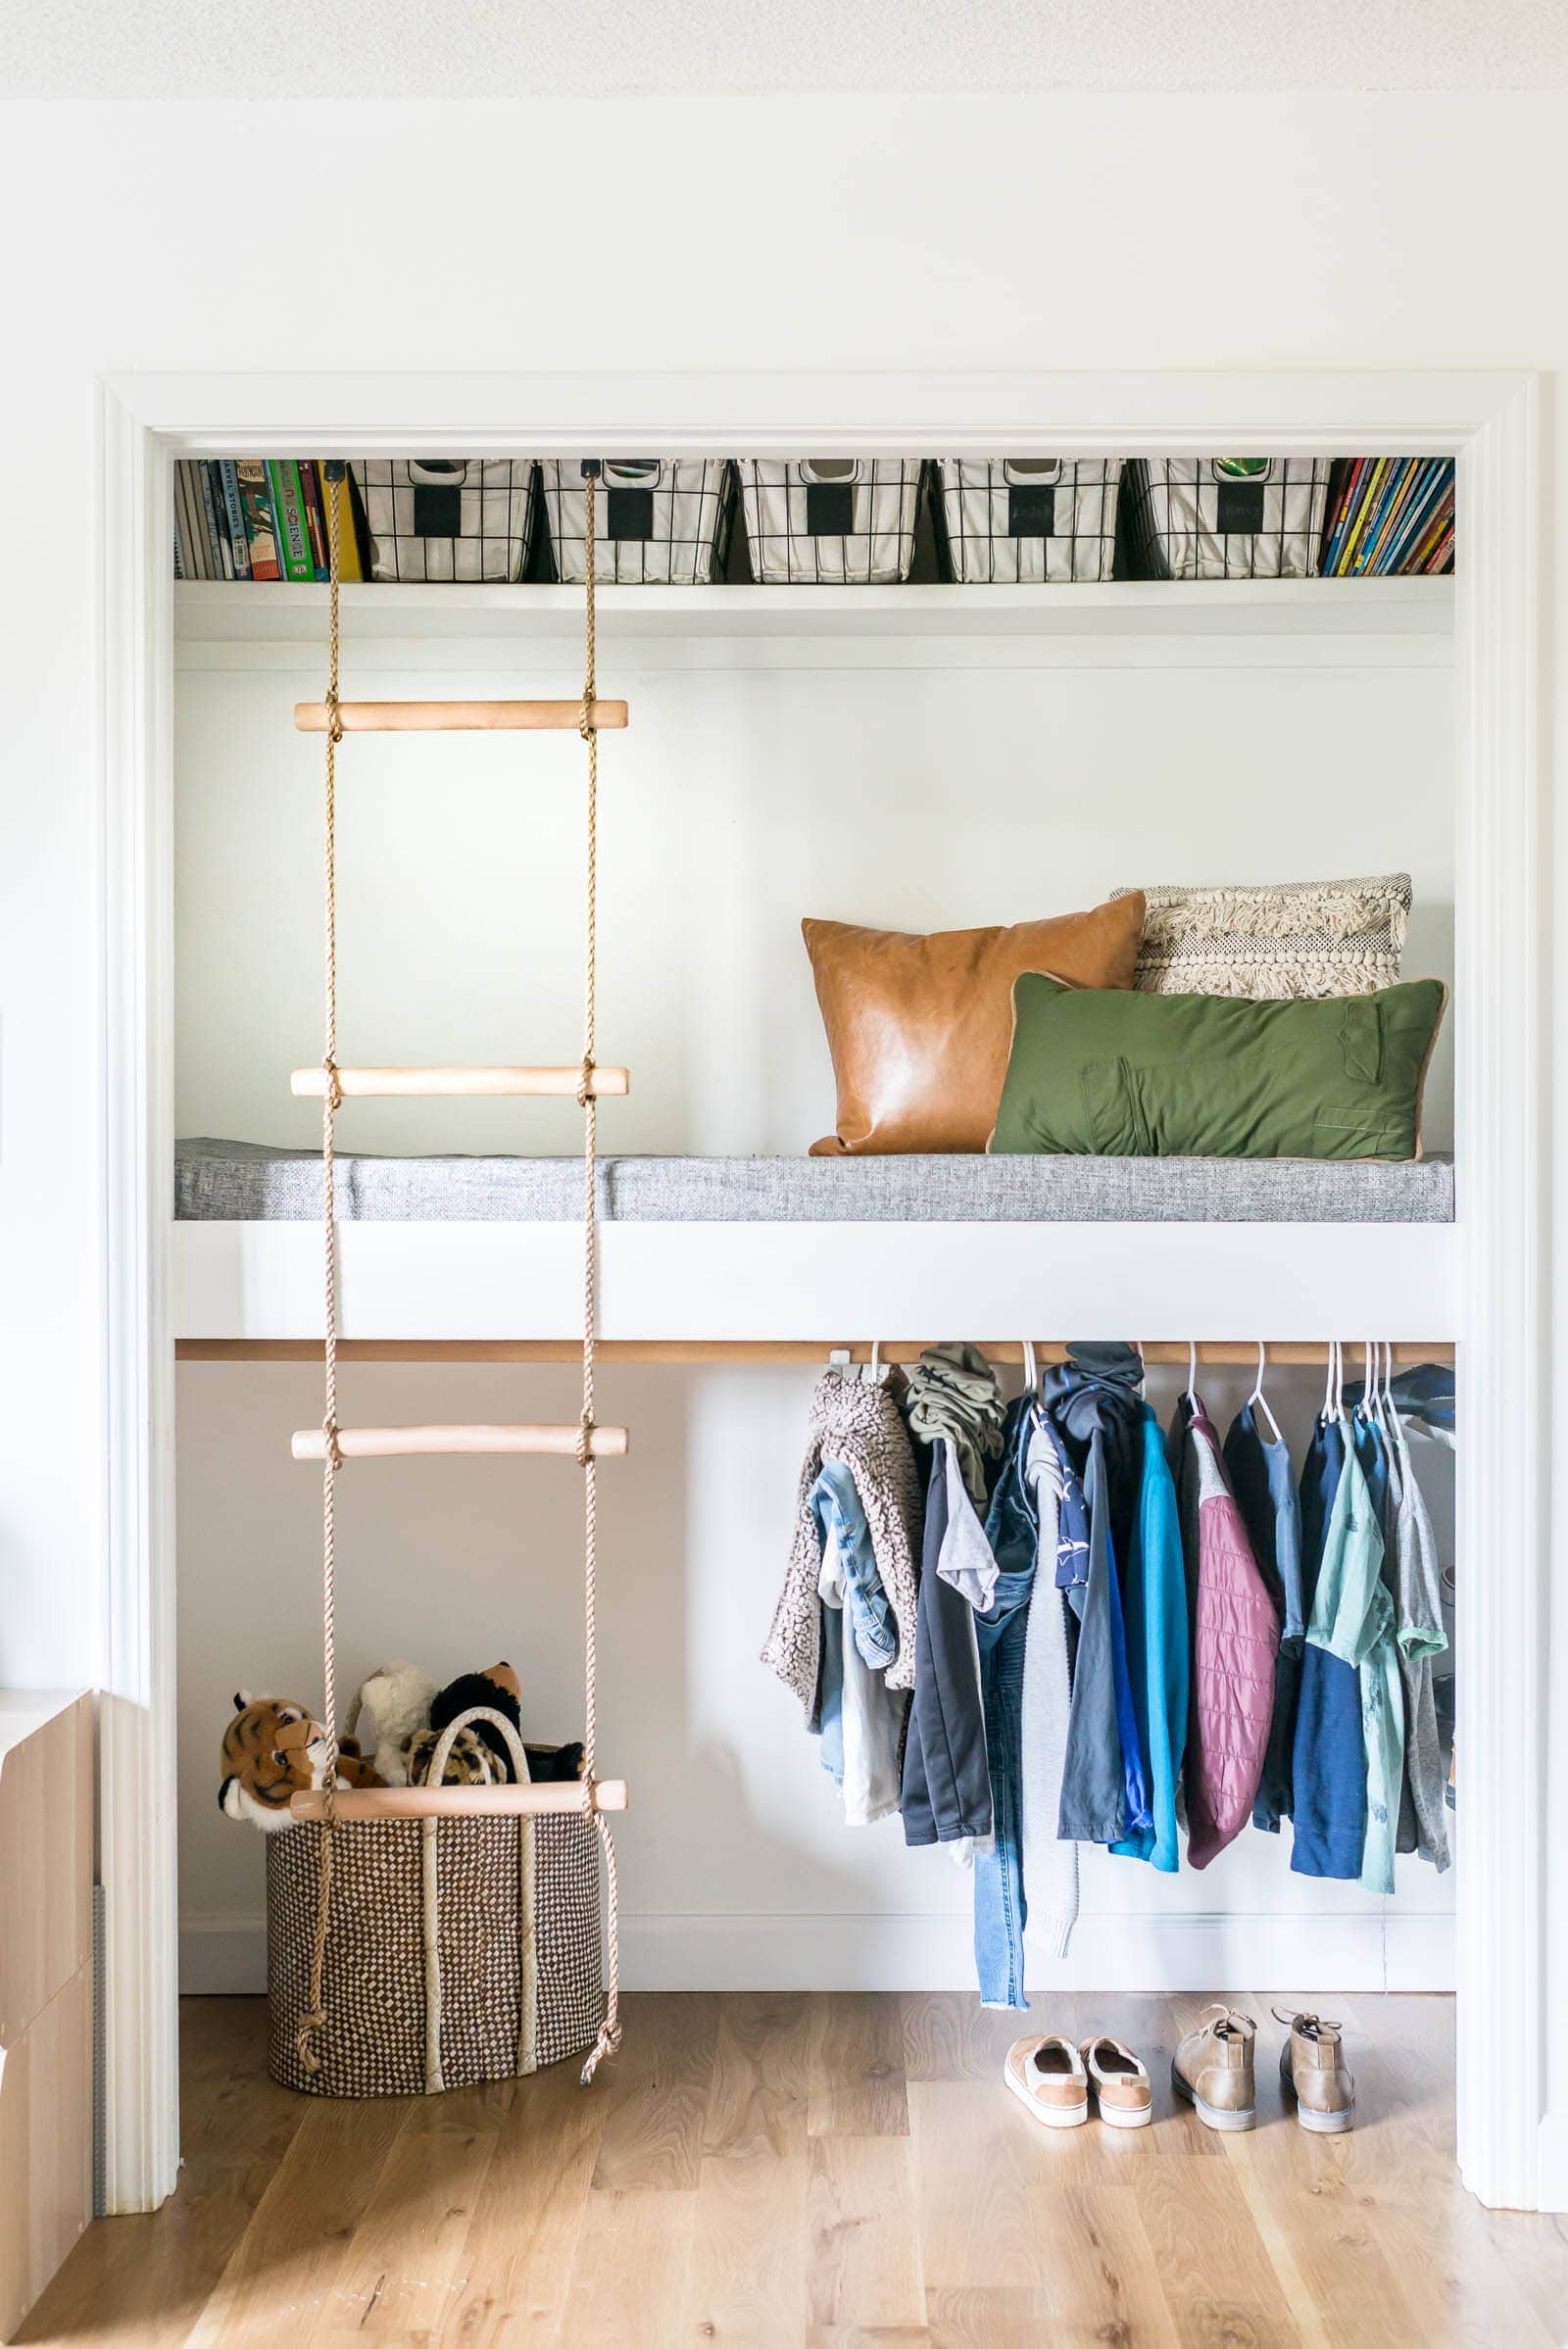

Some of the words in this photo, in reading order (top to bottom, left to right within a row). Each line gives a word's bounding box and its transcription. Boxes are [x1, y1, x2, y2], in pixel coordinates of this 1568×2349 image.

[223, 461, 234, 490] ARVEL
[228, 492, 240, 527] STORIES
[286, 508, 303, 558] SCIENCE
